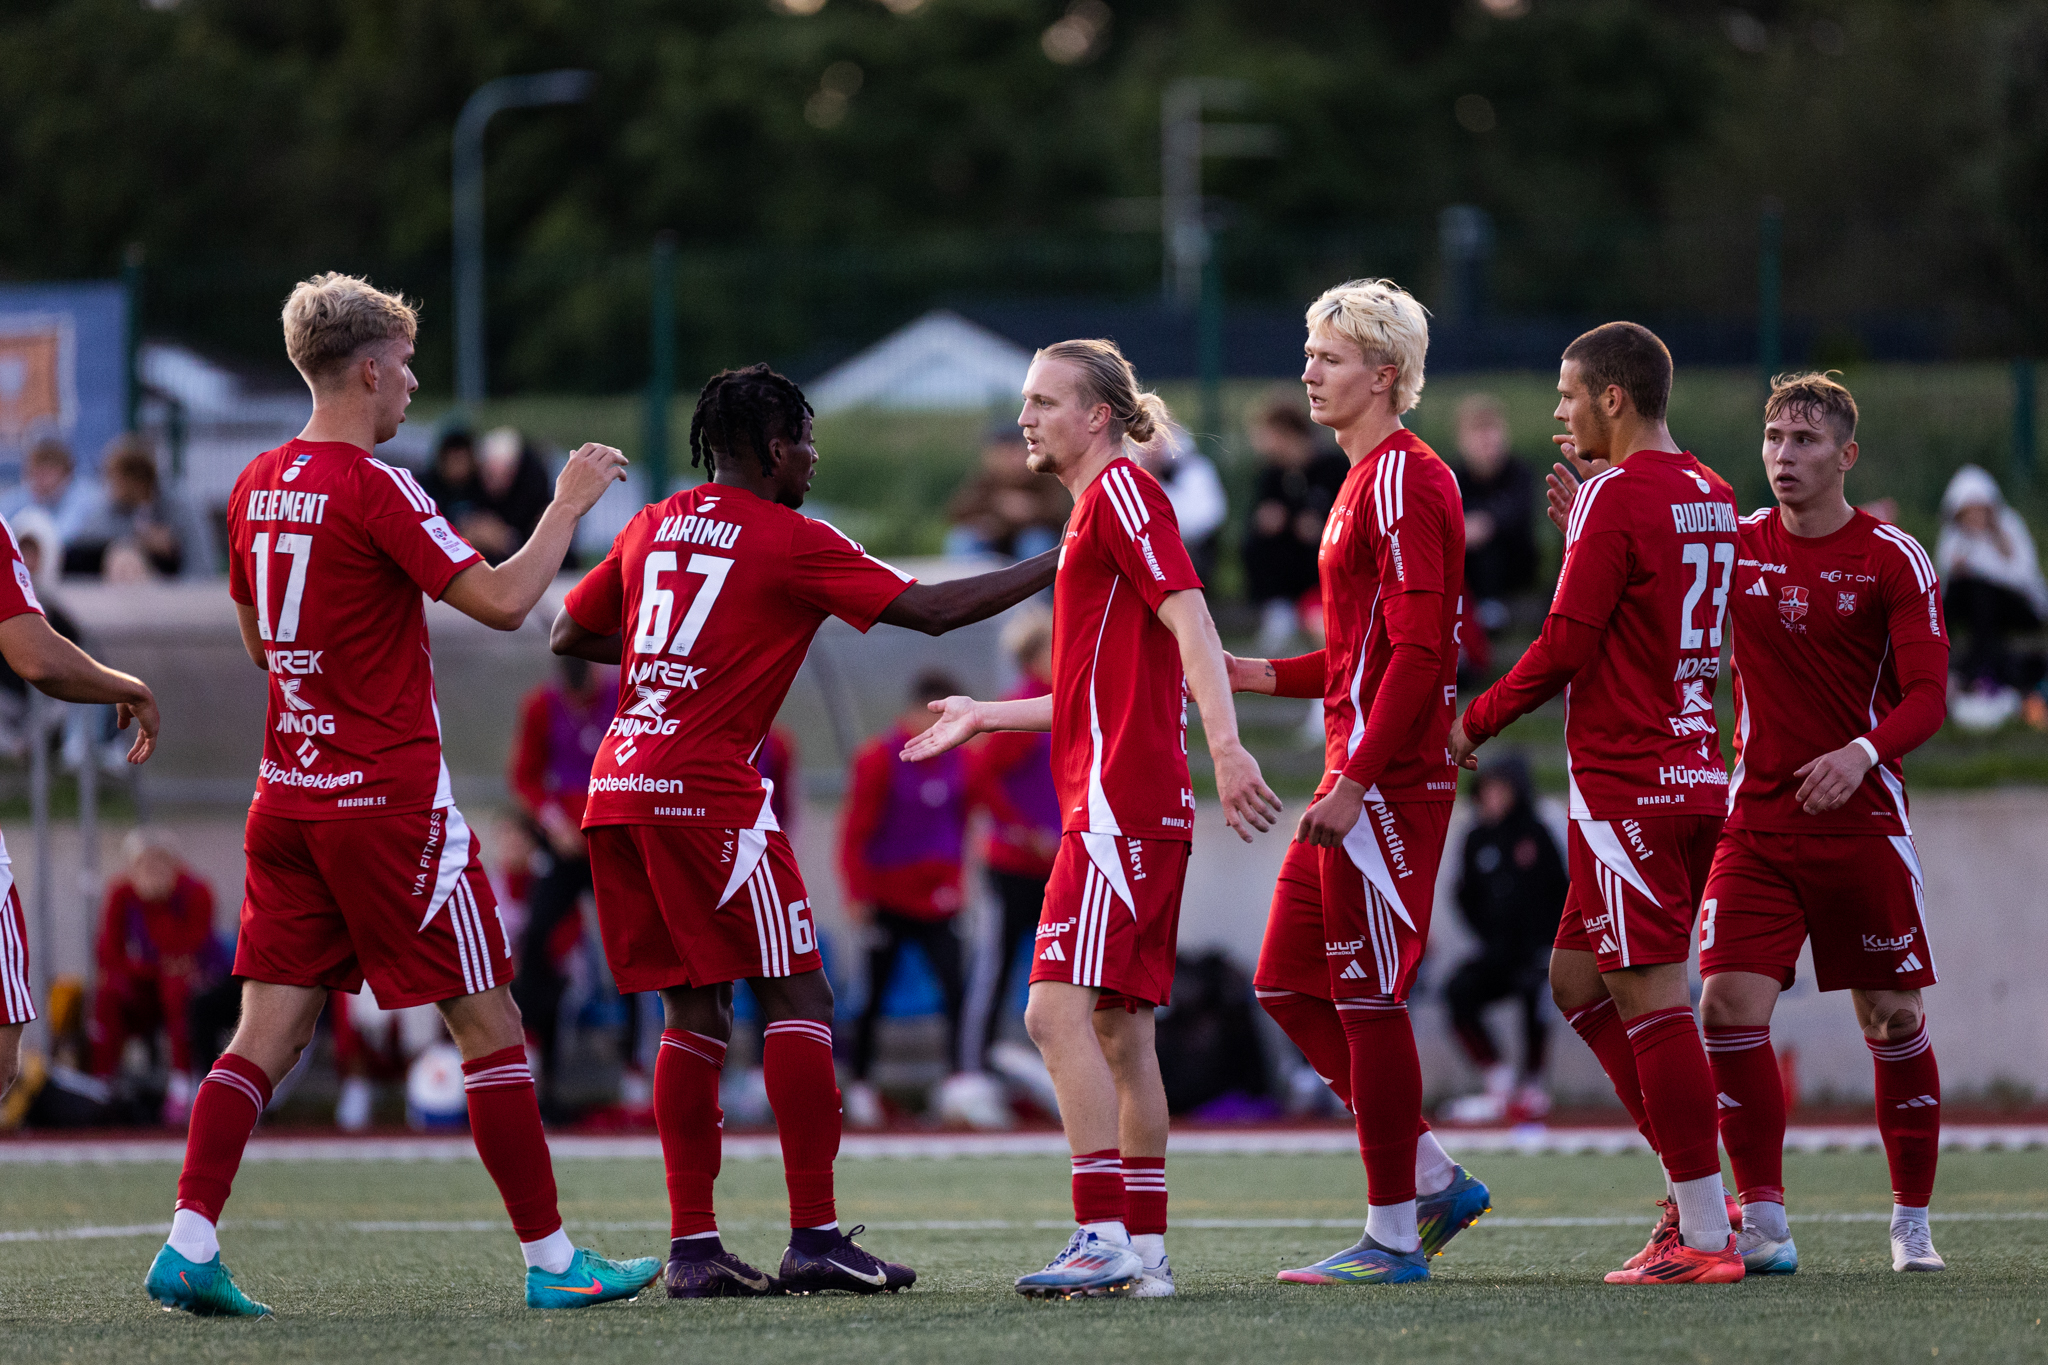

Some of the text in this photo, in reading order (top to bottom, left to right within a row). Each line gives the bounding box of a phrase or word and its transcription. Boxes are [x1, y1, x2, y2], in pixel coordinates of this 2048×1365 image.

[246, 489, 329, 525] KELEMENT
[653, 514, 742, 549] KARIMU
[1136, 532, 1166, 582] YENEMAT
[1387, 528, 1405, 582] YENEMAT
[251, 532, 313, 643] 17
[633, 550, 735, 657] 67
[1680, 542, 1734, 650] 23
[1927, 588, 1941, 637] YENEMAT
[338, 796, 387, 808] HARJUJK.EE
[654, 806, 706, 817] HARJUJK.EE
[1637, 794, 1685, 806] @HARJU_JK
[411, 812, 441, 896] VIA FITNESS
[720, 840, 734, 863] VIA
[1371, 801, 1414, 879] piletilevi
